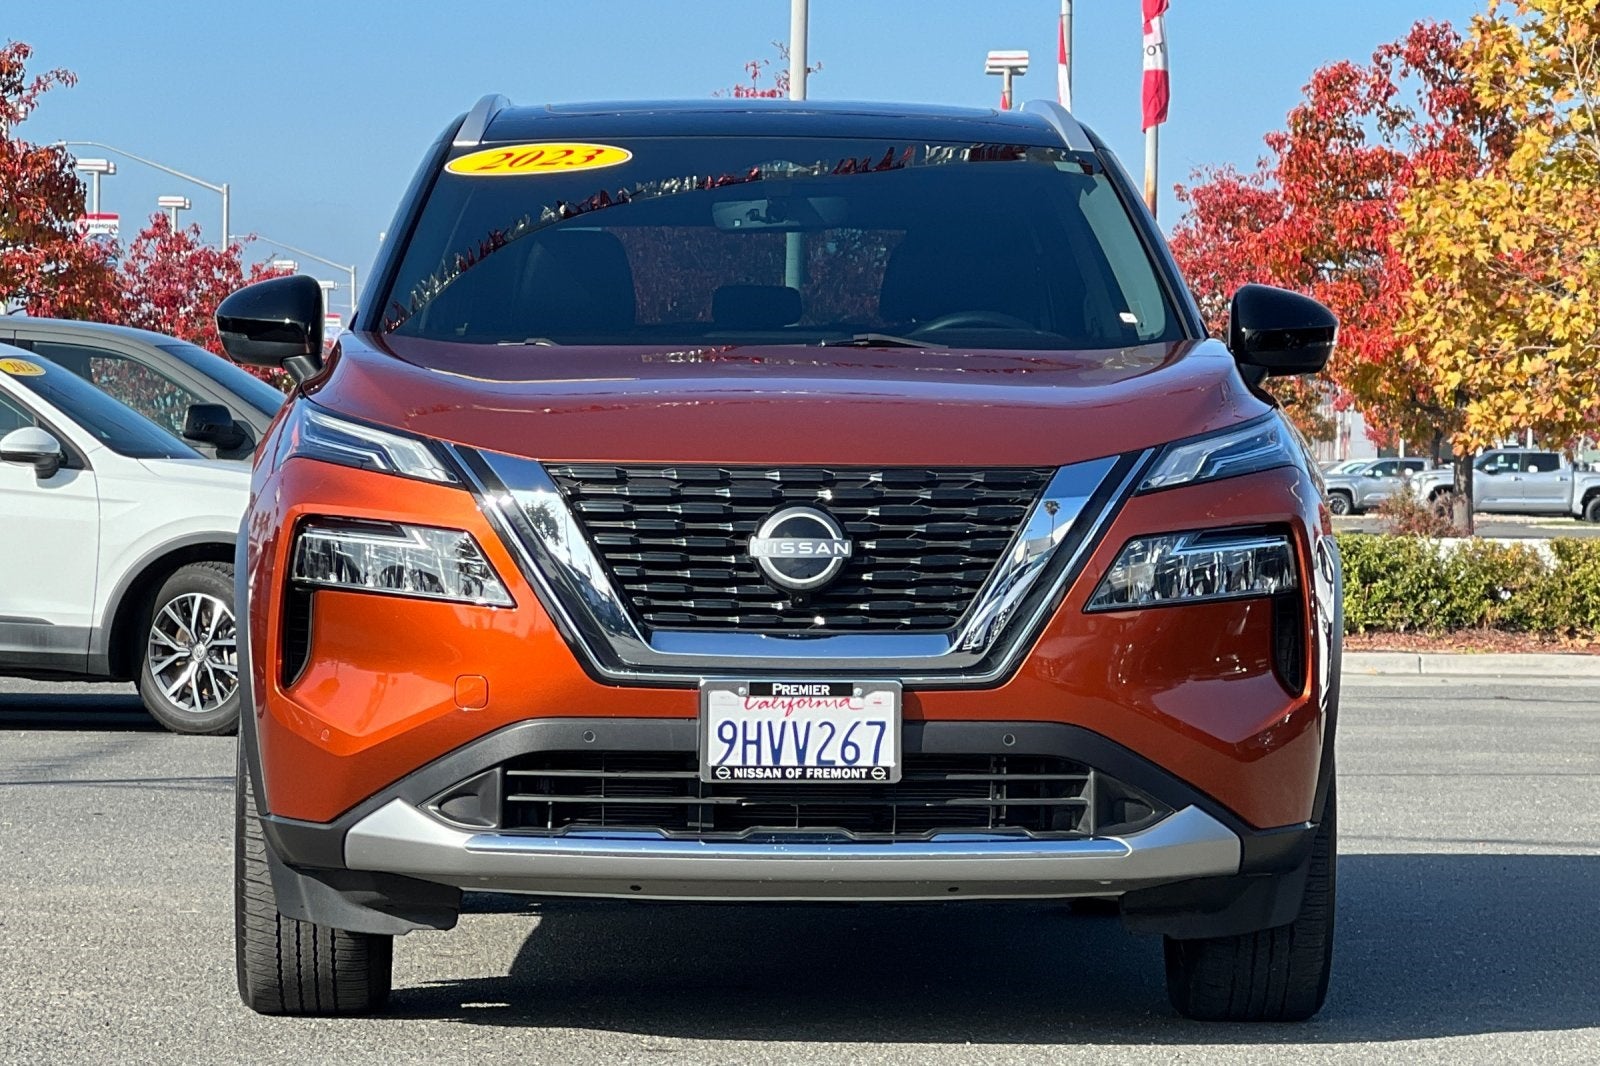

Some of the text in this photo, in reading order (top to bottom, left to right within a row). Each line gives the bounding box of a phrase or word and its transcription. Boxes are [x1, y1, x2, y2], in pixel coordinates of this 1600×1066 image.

[475, 149, 604, 170] 2023
[753, 542, 849, 555] NISSAN
[772, 683, 830, 695] PREMIER
[743, 696, 863, 716] California
[717, 720, 886, 766] 9HVV267
[734, 768, 781, 778] NISSAN
[786, 768, 802, 778] OF
[806, 768, 868, 778] FREMONT
